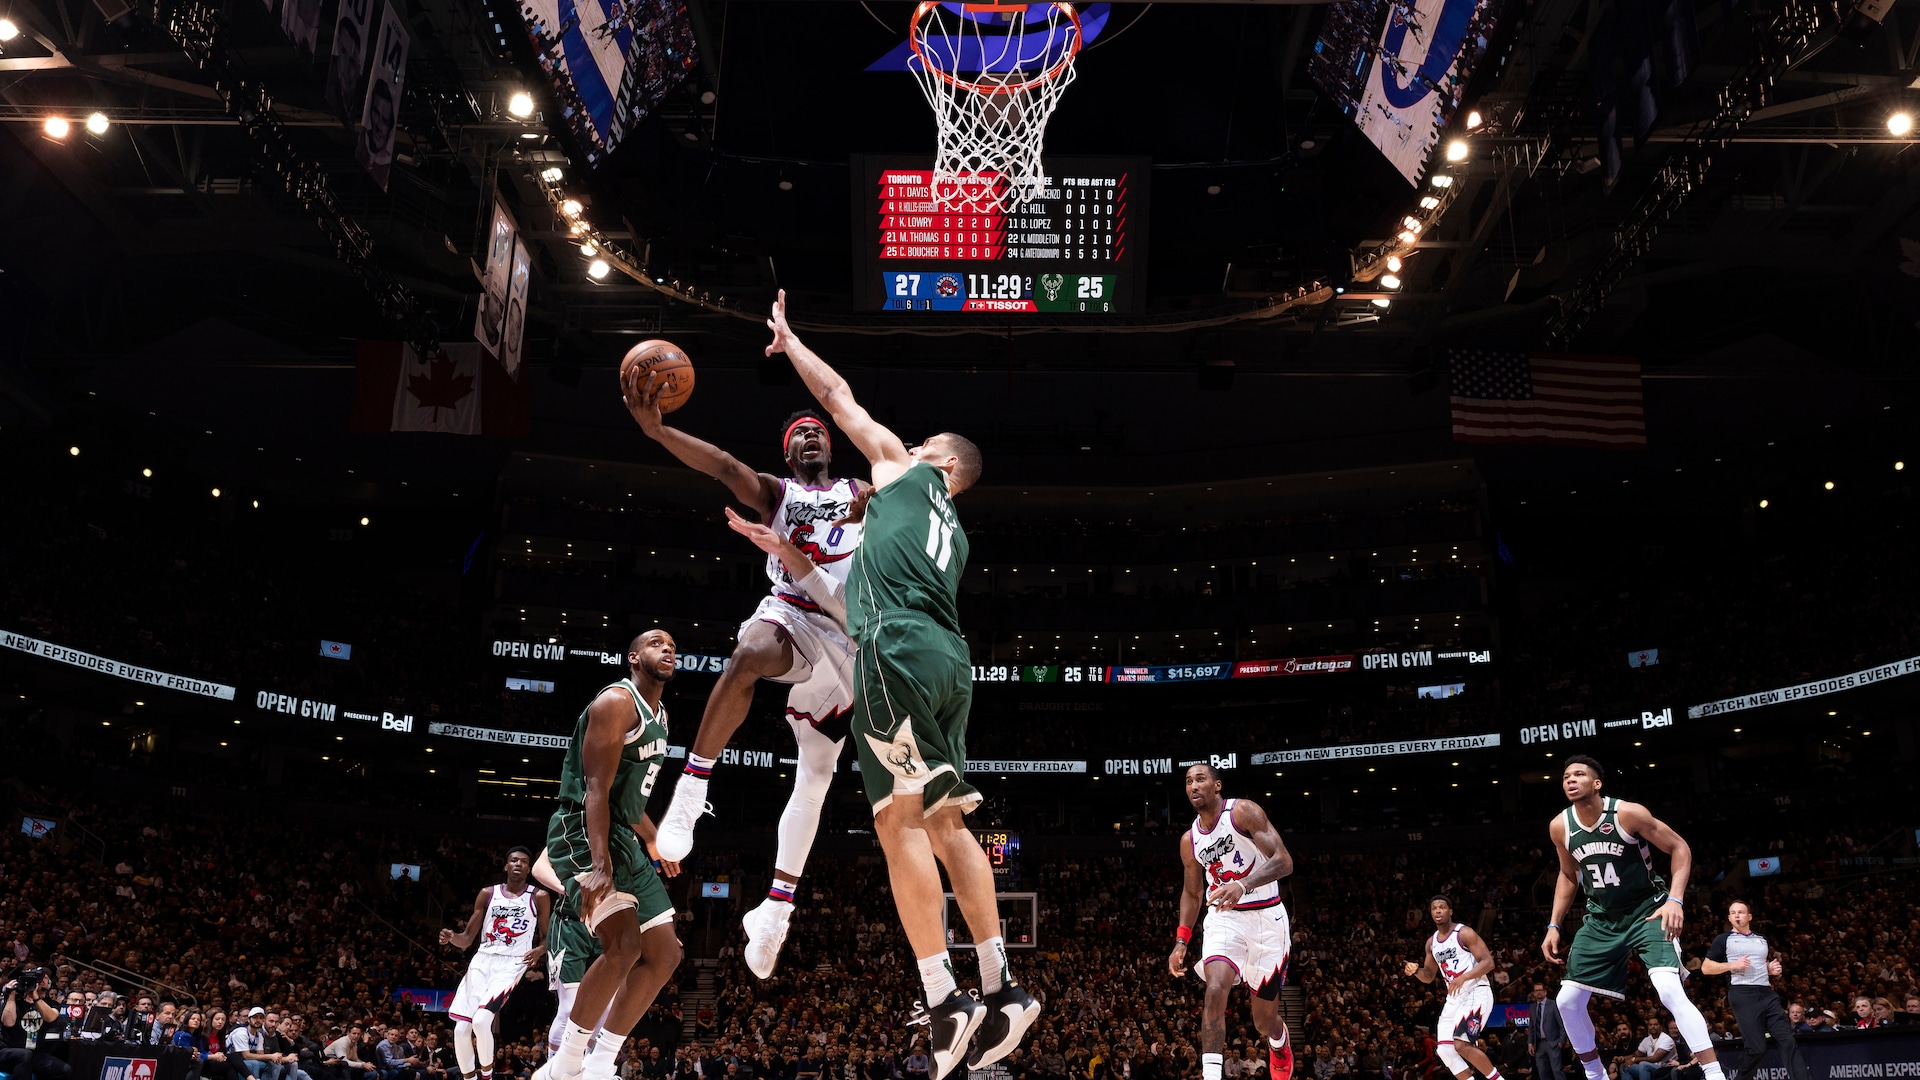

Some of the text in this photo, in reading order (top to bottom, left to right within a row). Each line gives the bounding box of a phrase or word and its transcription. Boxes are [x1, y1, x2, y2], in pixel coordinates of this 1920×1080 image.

[887, 175, 922, 184] TORONTO
[1063, 178, 1076, 186] PTS
[889, 187, 929, 197] 0 T. DAVIS
[1011, 189, 1113, 200] 0 0 1 1 0
[889, 202, 894, 212] 4
[1021, 204, 1112, 215] G. HILL 0 0 0 0
[889, 217, 990, 228] 7 K. LOWRY 3 2 2 0
[1008, 219, 1111, 230] 11 B. LOPEZ 6 1 0 1
[887, 232, 990, 243] 21 M. THOMAS 0 0 0 1
[1008, 234, 1111, 245] 22 K. MIDDLETON 0 2 1 0
[887, 247, 990, 258] 25 C. BOUCHER 5 2 0 0
[1008, 248, 1097, 259] 34 5 5 3
[896, 274, 920, 296] 27
[968, 274, 1021, 299] 11:29
[1025, 277, 1031, 290] 2
[1078, 277, 1103, 298] 25
[906, 300, 912, 309] 6
[986, 301, 1028, 310] TISSOT
[1103, 302, 1109, 312] 6
[929, 483, 958, 532] LOPEZ
[826, 526, 844, 547] 0
[925, 508, 953, 573] 11
[492, 640, 622, 666] OPEN GYM PRESENTED Bell
[5, 634, 220, 696] NEW EPISODES EVERY FRIDAY
[1296, 660, 1351, 672] redtag.ca
[1362, 653, 1398, 670] OPEN
[1401, 651, 1432, 668] GYM
[1469, 650, 1490, 664] Bell
[971, 666, 1007, 682] 11:29
[1012, 666, 1018, 675] 2
[1064, 667, 1081, 682] 25
[1168, 666, 1221, 680] $15,697
[1240, 666, 1270, 674] PRESENTED
[1088, 674, 1096, 682] TO
[1703, 664, 1901, 716] CATCH NEW EPISODES EVERY
[256, 690, 414, 733] OPEN GYM PRESENTED Bell
[1019, 702, 1104, 711] DRAUGHT DECK
[1519, 708, 1673, 745] OPEN GYM PRESENTED Bell
[443, 725, 484, 739] CATCH
[488, 730, 516, 742] NEW
[1263, 737, 1486, 763] CATCH NEW EPISODES EVERY FRIDAY
[716, 749, 773, 768] PEN GYM
[1104, 753, 1237, 775] OPEN GYM Bell
[994, 762, 1029, 771] EVERY
[1033, 762, 1074, 772] FRIDAY
[171, 786, 187, 798] 111
[979, 833, 1007, 845] 11:28
[1407, 832, 1423, 841] 115
[1120, 839, 1136, 849] 114
[1233, 850, 1245, 867] 4
[1586, 862, 1620, 889] 34
[511, 917, 529, 931] 25
[1452, 959, 1459, 970] 7
[1829, 1064, 1883, 1079] AMERICAN
